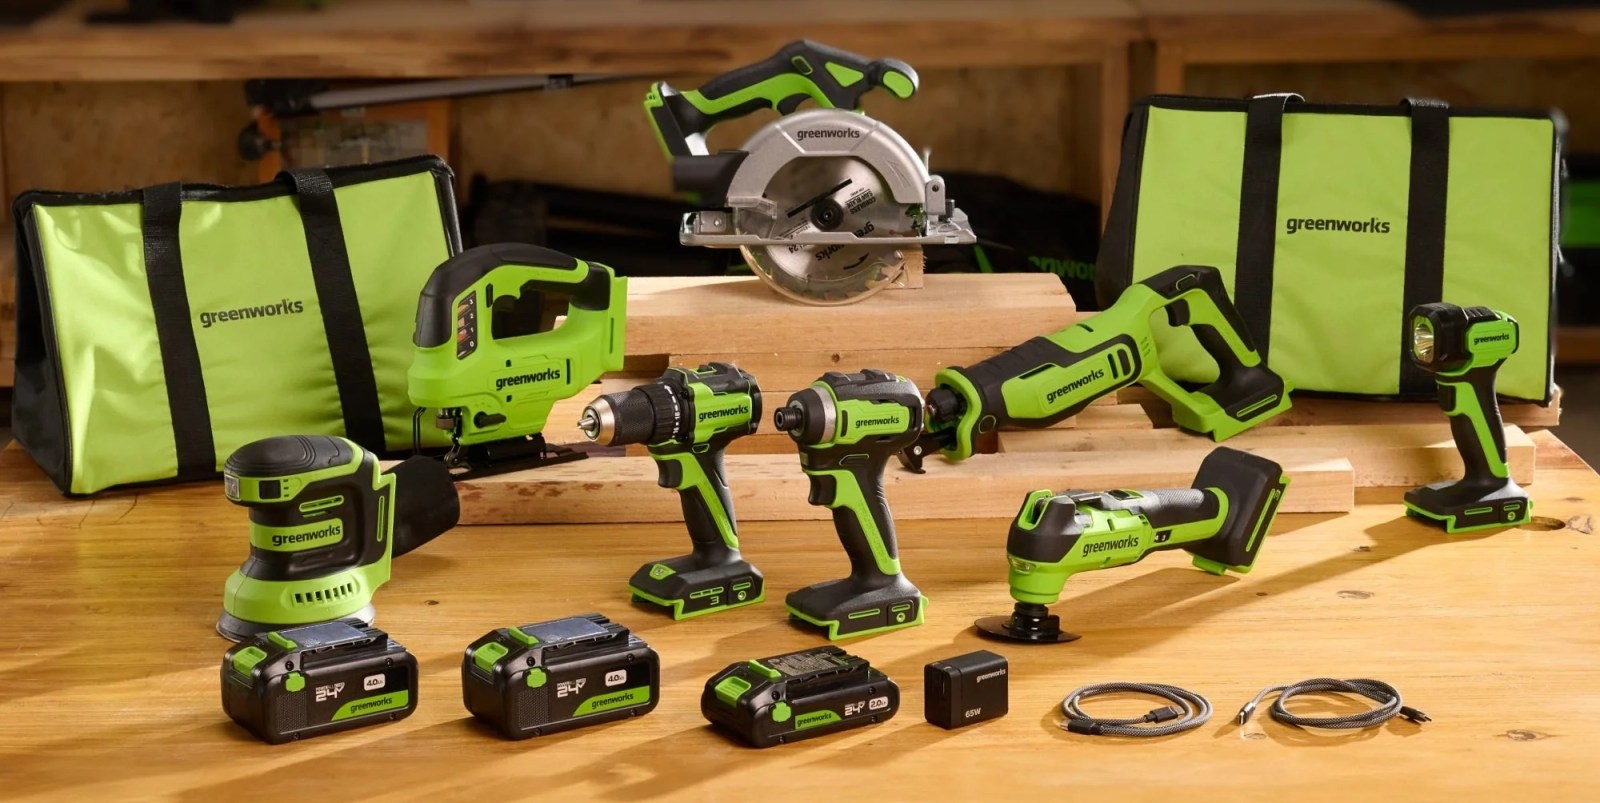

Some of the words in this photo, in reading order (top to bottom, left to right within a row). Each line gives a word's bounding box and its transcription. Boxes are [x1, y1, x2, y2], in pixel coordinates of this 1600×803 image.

[797, 128, 860, 141] greenworks
[1286, 217, 1391, 235] greenworks
[199, 298, 304, 328] greenworks
[1473, 332, 1510, 346] greenworks
[496, 368, 561, 391] greenworks
[1046, 368, 1105, 405] greenworks
[698, 404, 749, 423] greenworks
[855, 416, 900, 429] greenworks
[271, 525, 341, 547] greenworks
[1082, 534, 1140, 558] greenworks
[976, 668, 1007, 684] greenworks
[350, 696, 393, 714] greenworks
[591, 692, 634, 710] greenworks
[796, 709, 833, 727] greenworks
[964, 707, 982, 718] 65W
